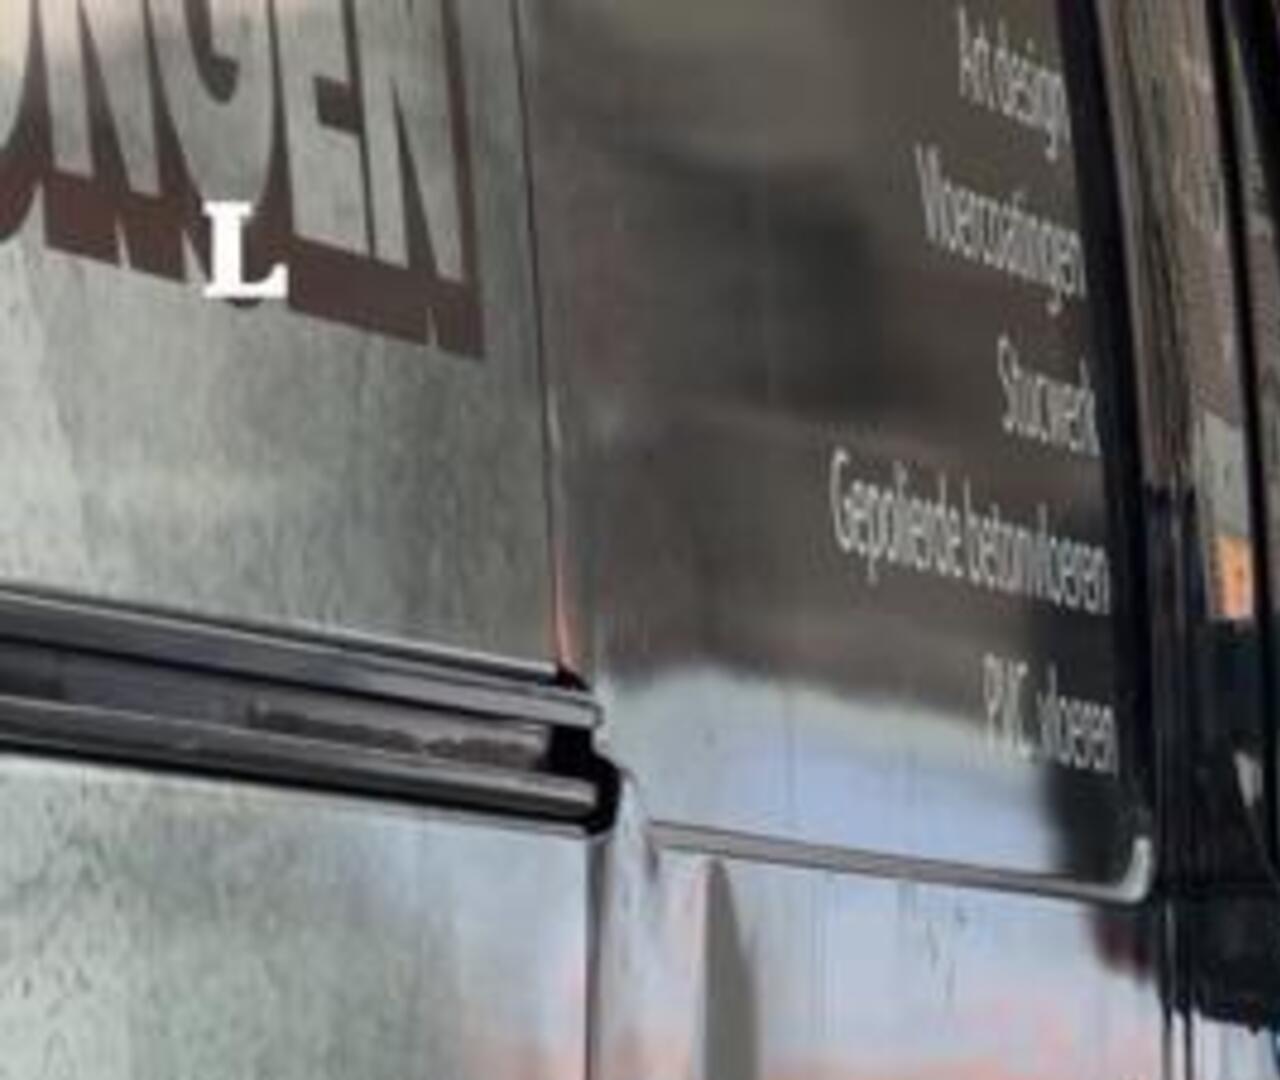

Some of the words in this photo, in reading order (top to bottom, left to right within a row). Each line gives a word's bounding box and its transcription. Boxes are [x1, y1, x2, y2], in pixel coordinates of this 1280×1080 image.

[998, 333, 1101, 457] Stucwerk
[829, 446, 964, 588] Gepolierde
[964, 475, 1112, 616] betonvloeren
[1036, 662, 1119, 780] vloeren
